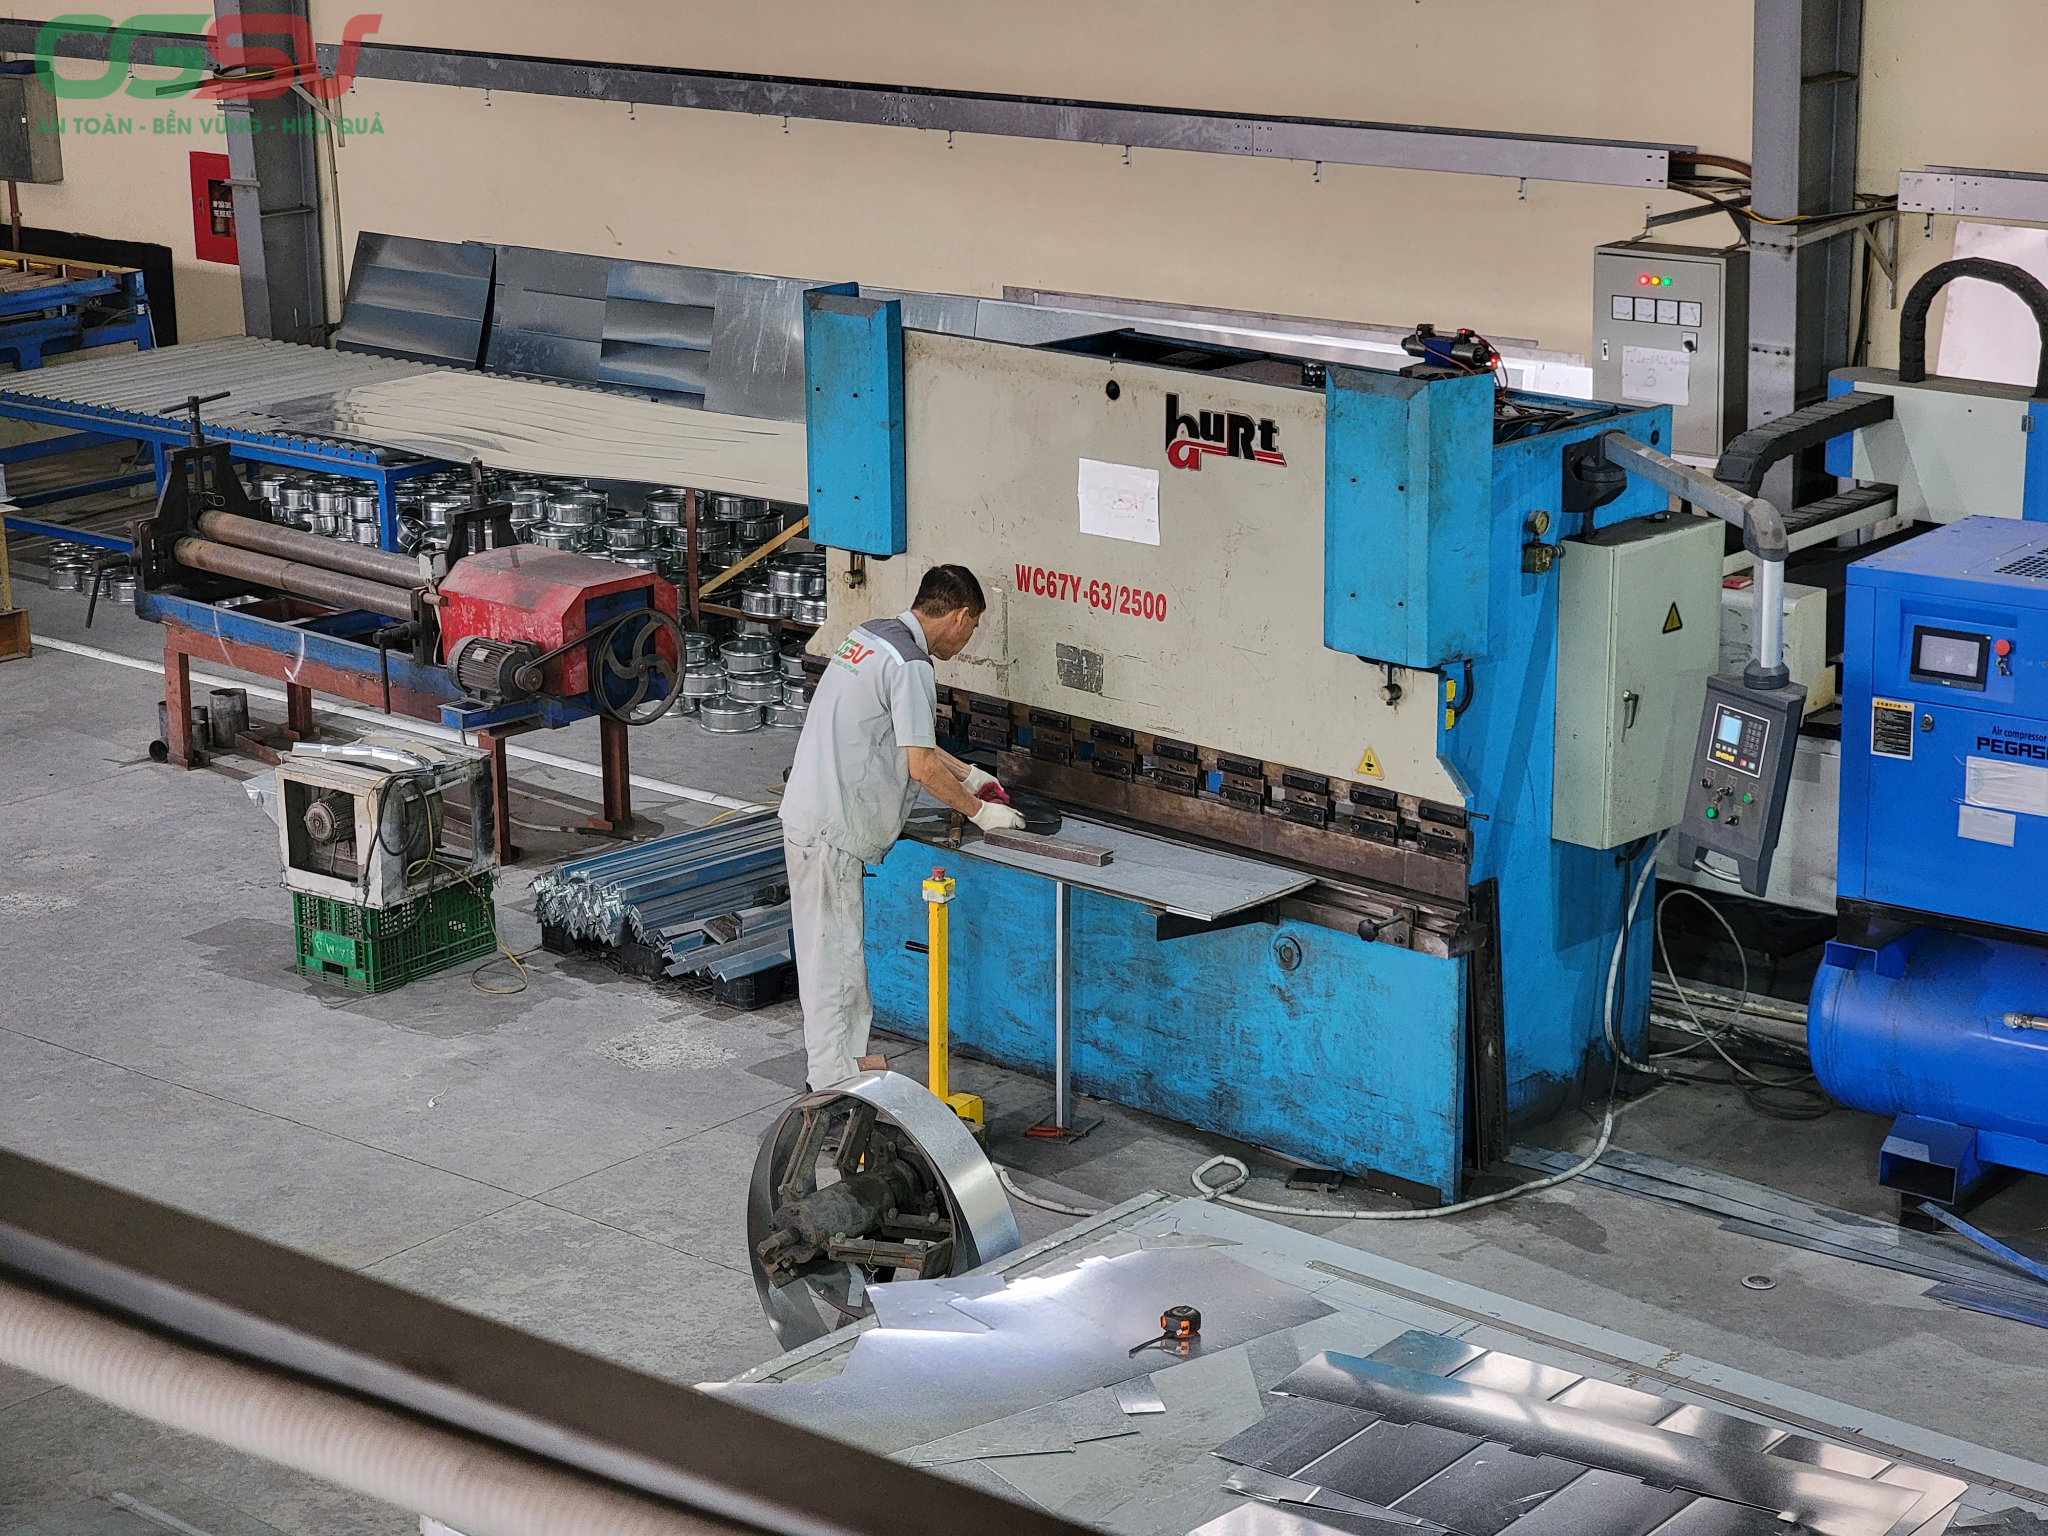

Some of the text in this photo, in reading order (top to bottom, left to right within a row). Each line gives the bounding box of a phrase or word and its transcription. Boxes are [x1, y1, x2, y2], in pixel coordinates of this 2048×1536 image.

[1015, 563, 1167, 622] WC67Y-63/2500
[835, 637, 876, 665] GSV
[1992, 725, 2047, 743] Air compressor
[1976, 736, 2048, 761] PEGAS
